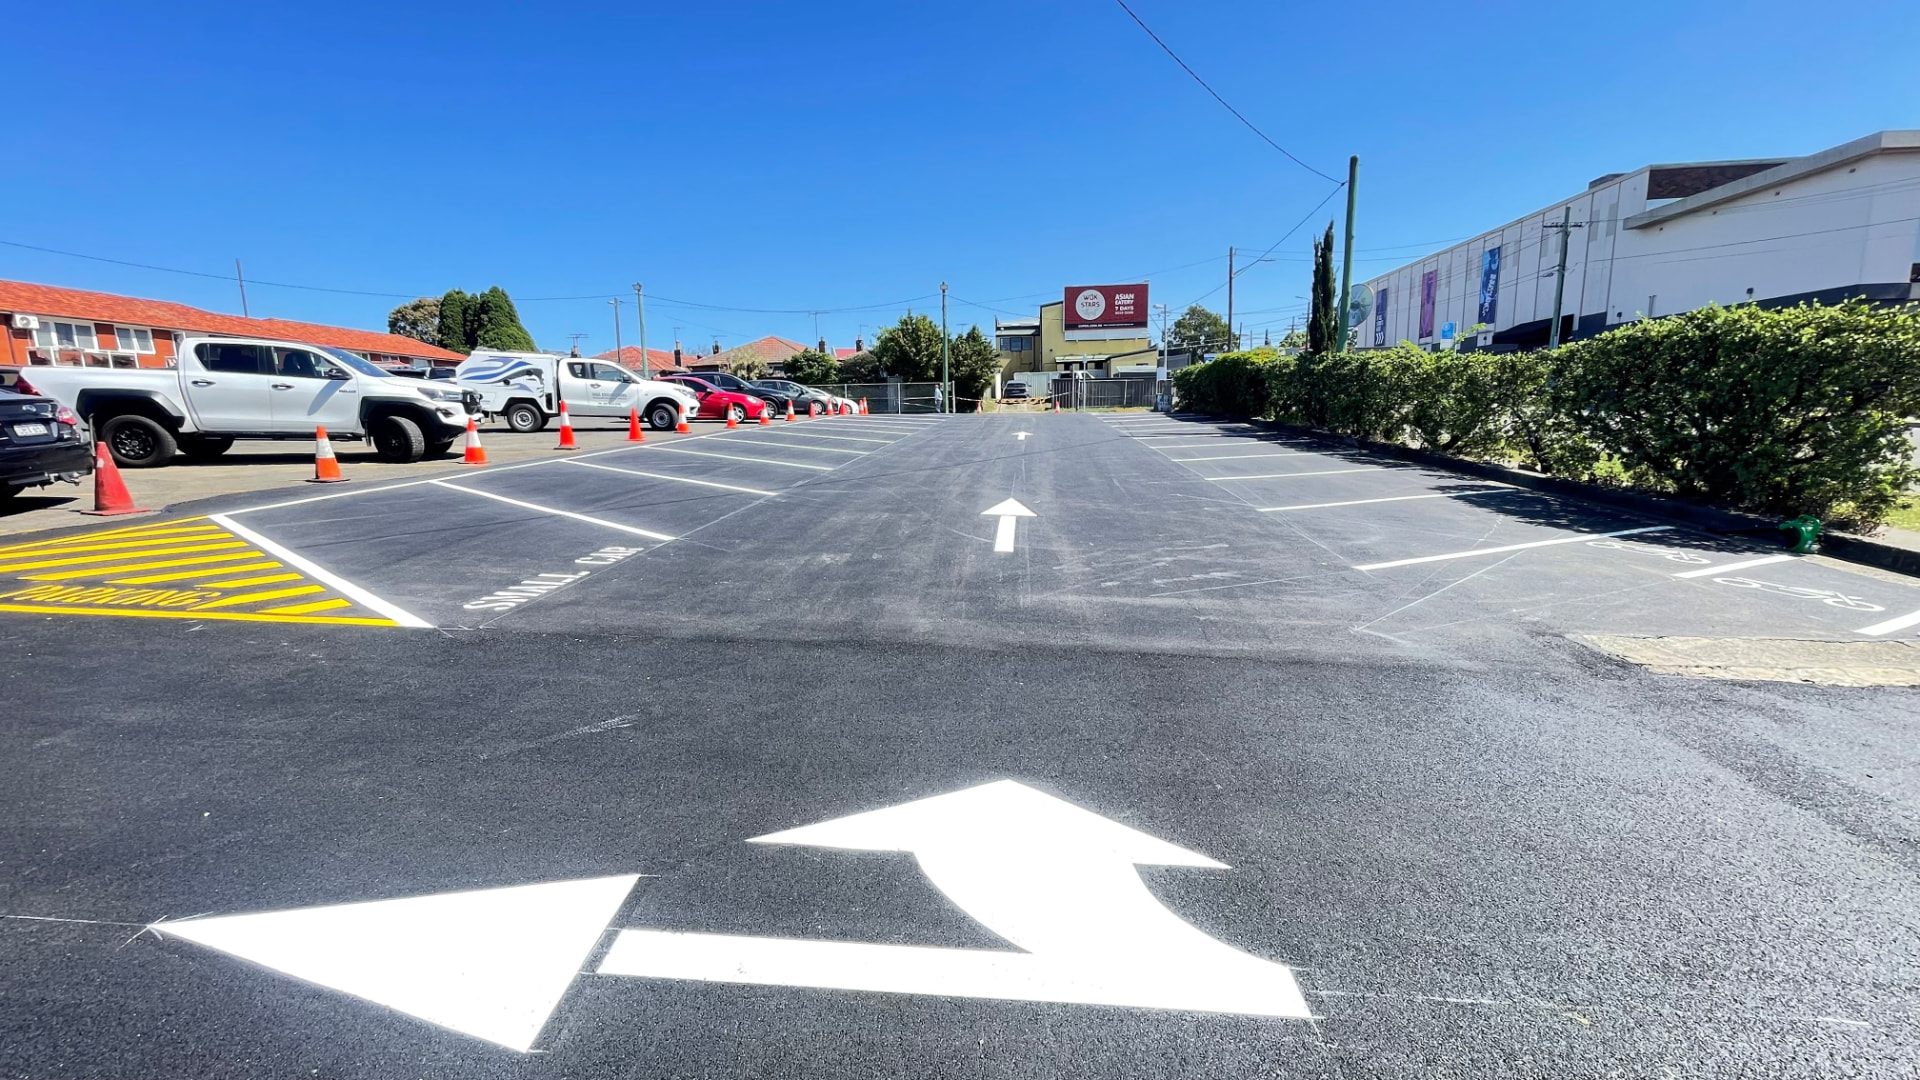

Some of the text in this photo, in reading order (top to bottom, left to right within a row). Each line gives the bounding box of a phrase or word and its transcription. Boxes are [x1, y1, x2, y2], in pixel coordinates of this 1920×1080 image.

[0, 585, 221, 607] PARKING
[463, 546, 644, 611] SMALL CAR
